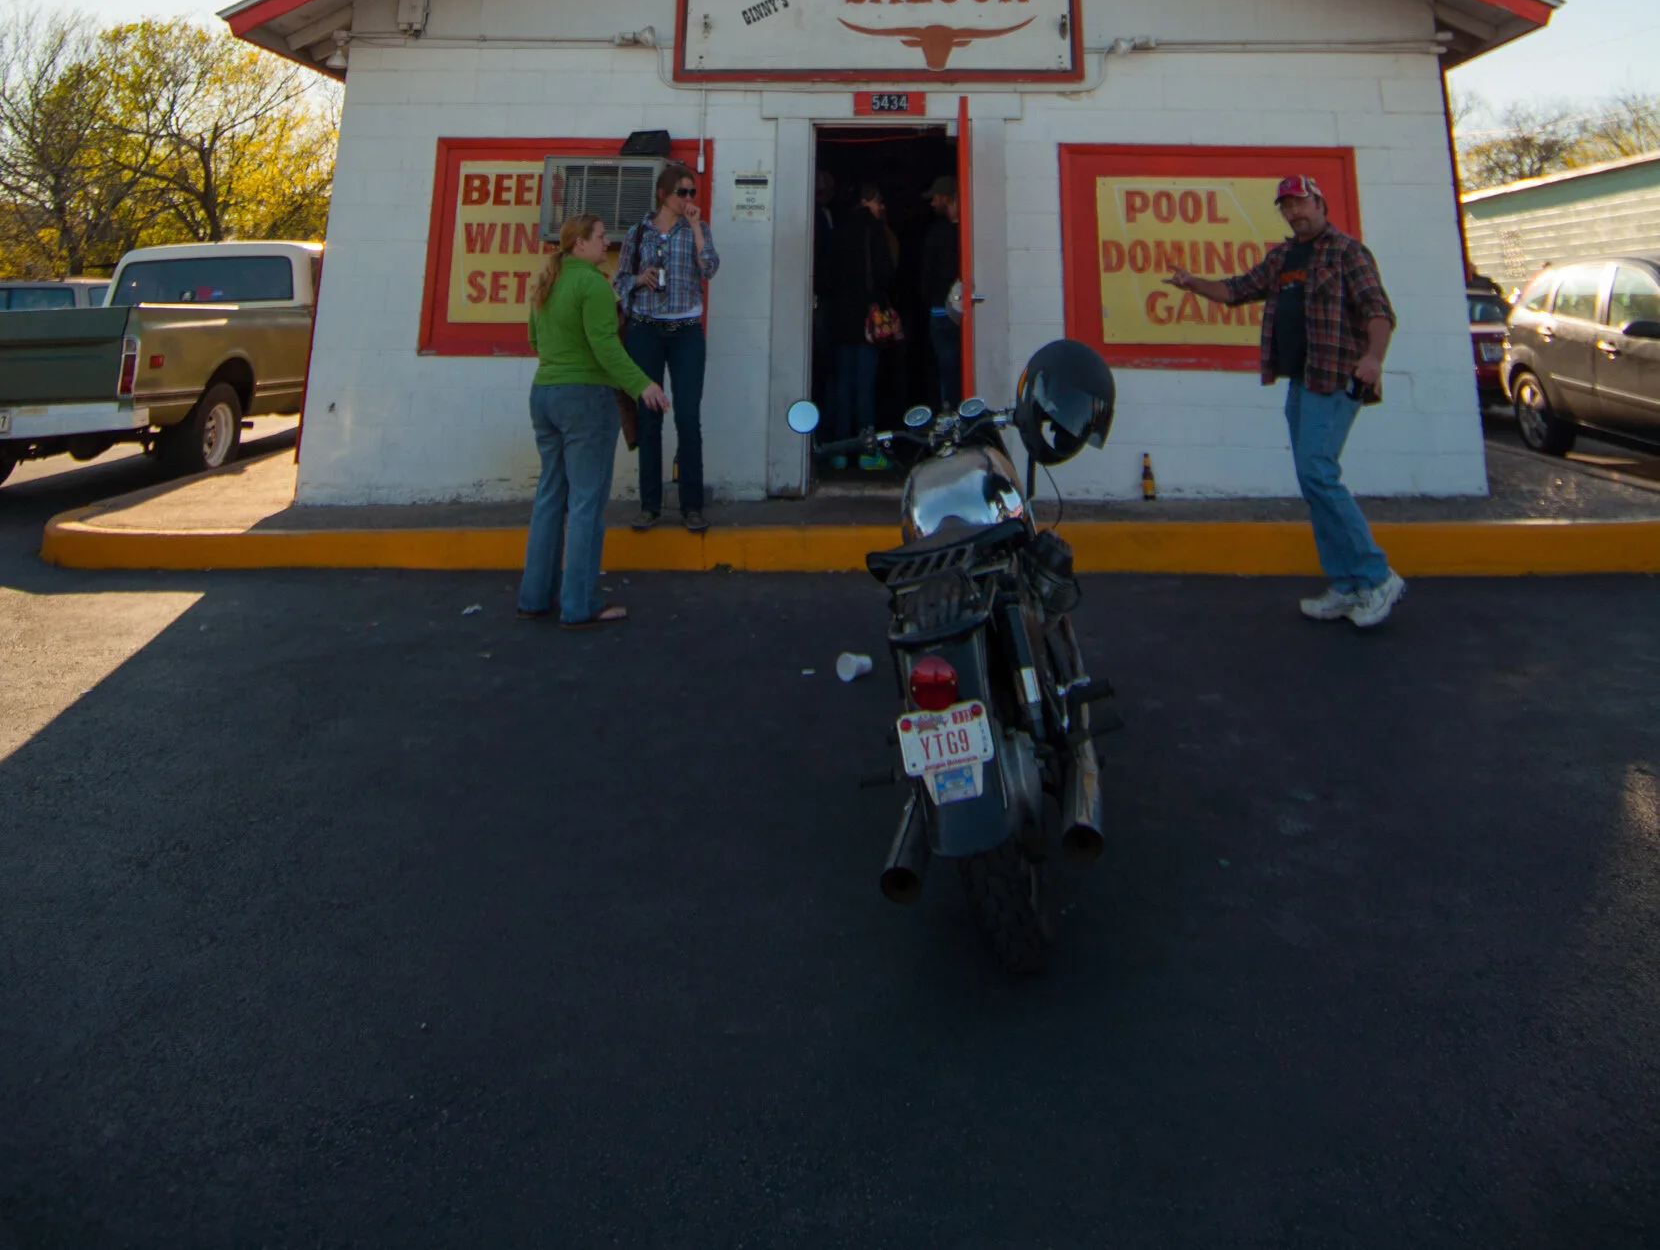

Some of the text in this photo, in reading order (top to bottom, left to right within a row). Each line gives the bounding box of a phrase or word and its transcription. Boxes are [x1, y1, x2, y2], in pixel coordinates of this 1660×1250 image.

[871, 94, 909, 111] 5434
[1125, 190, 1229, 224] POOL
[464, 222, 556, 255] WIN
[1101, 238, 1280, 274] DOMINO
[466, 270, 531, 304] SET
[919, 728, 970, 761] YTG9
